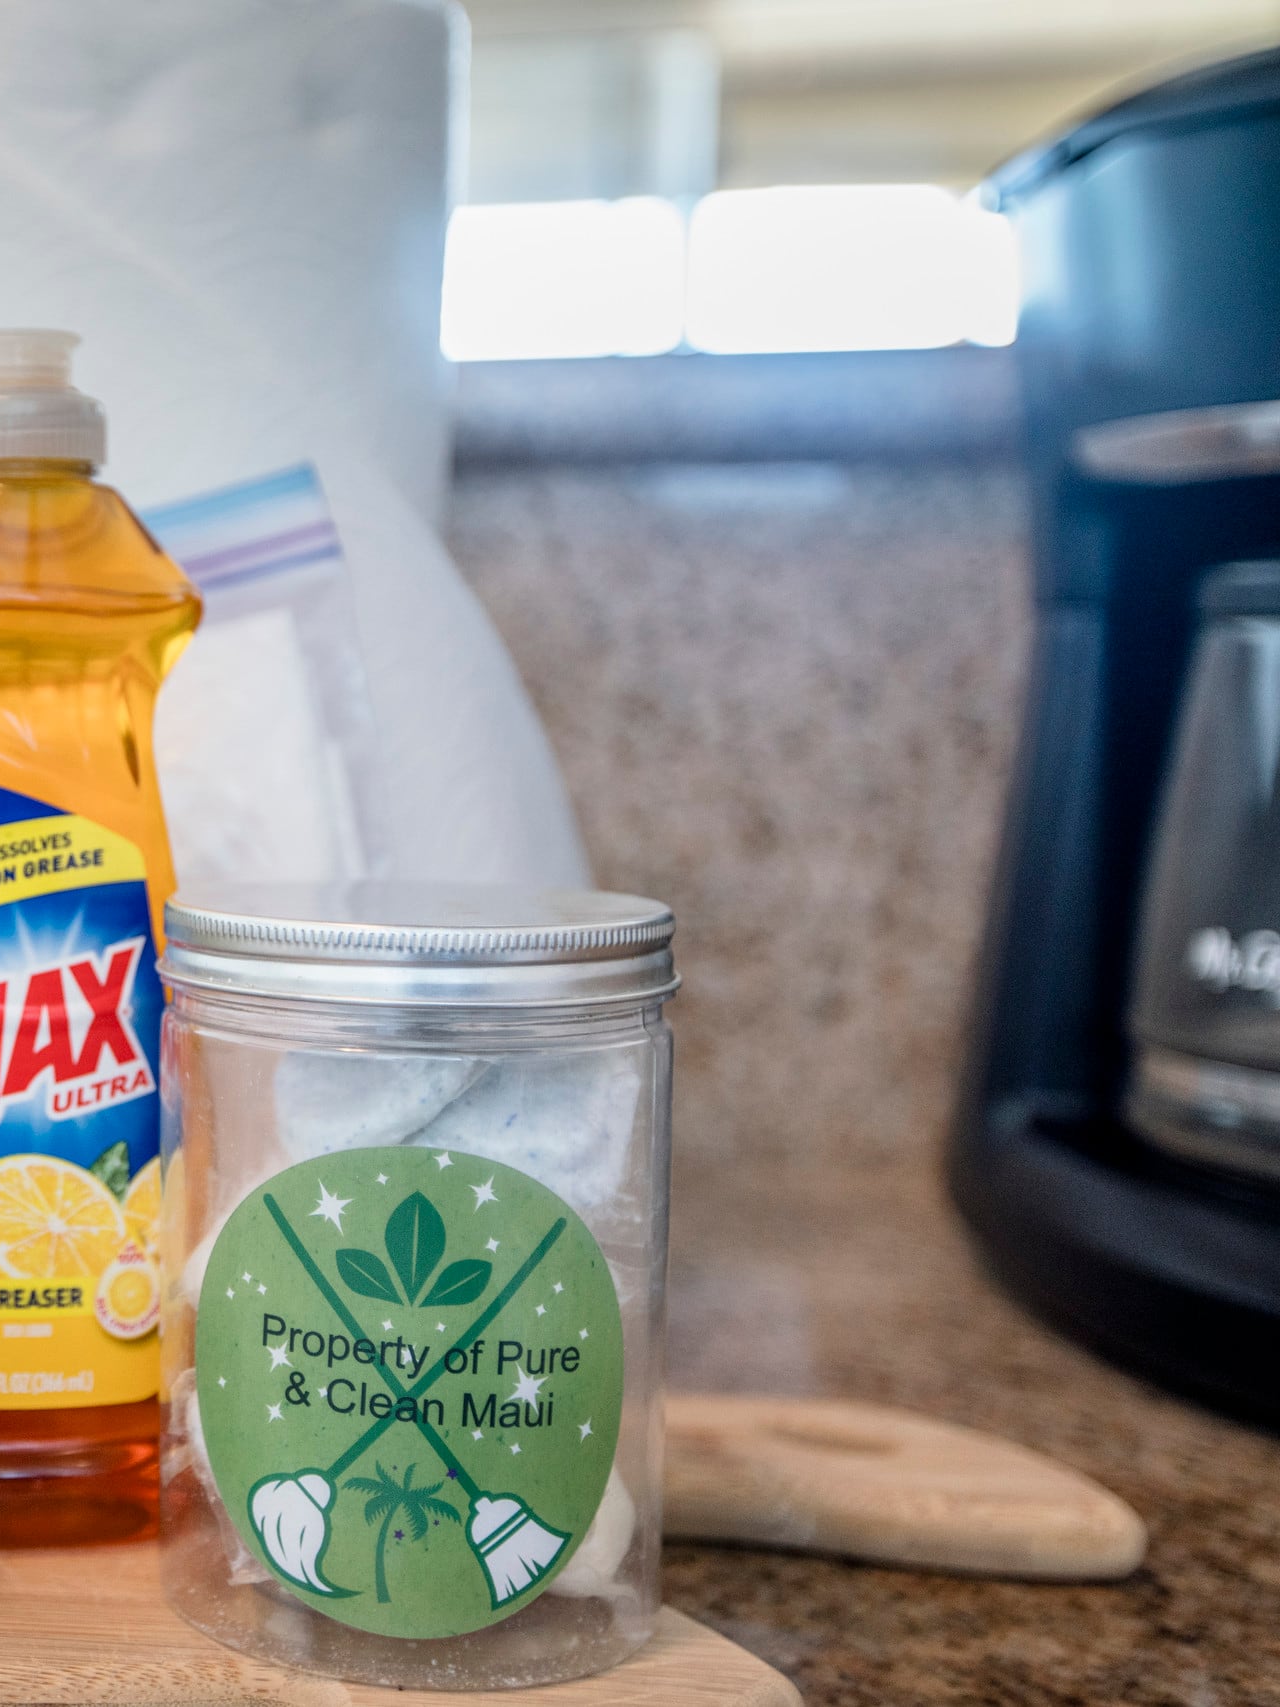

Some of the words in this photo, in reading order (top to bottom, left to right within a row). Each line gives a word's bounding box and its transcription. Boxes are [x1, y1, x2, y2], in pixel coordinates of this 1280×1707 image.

[22, 848, 105, 879] GREASE
[52, 1069, 150, 1114] ULTRA
[261, 1313, 430, 1378] Property
[443, 1340, 484, 1375] of
[496, 1340, 581, 1376] Pure
[284, 1371, 312, 1408] &
[325, 1378, 445, 1426] Clean
[461, 1391, 554, 1430] Maui
